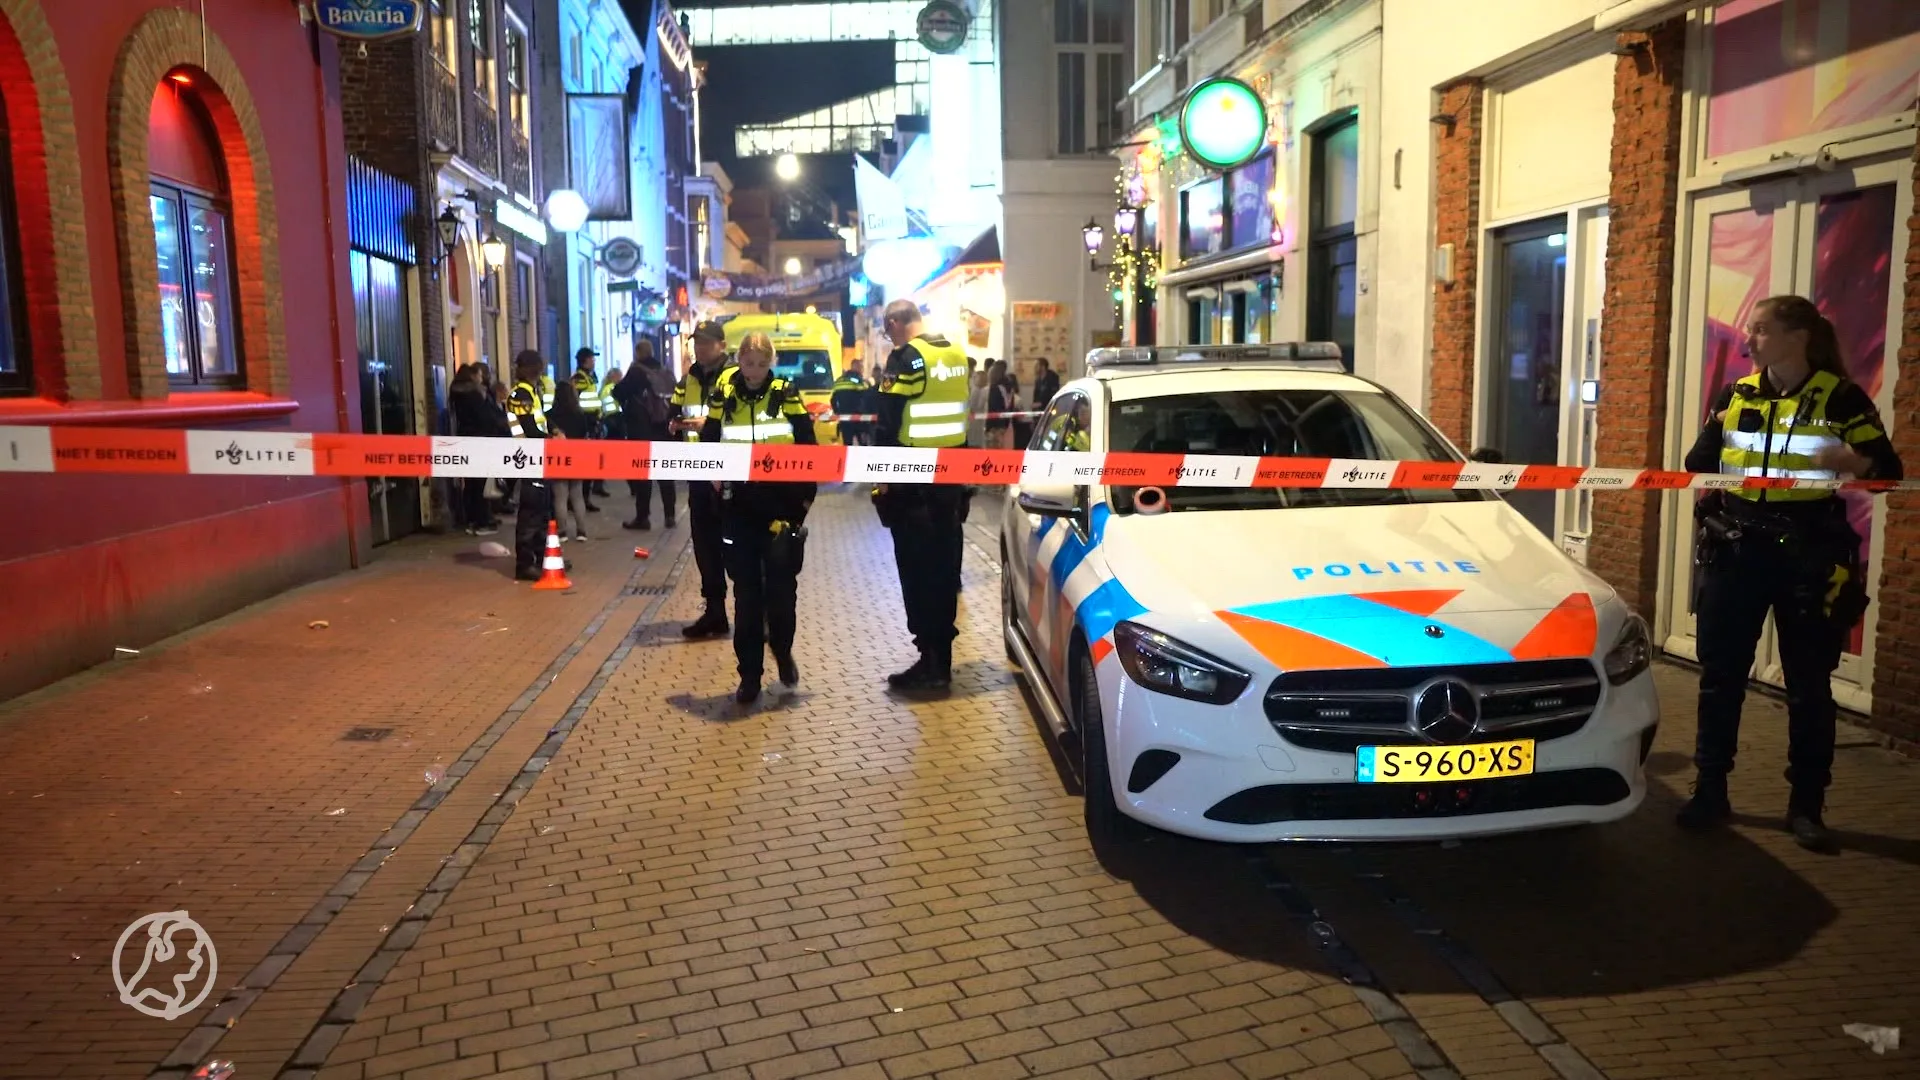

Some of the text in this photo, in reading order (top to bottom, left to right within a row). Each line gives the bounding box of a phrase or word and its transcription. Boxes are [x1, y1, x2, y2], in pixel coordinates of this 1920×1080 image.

[328, 6, 405, 25] Bavaria
[56, 447, 177, 461] NIET BETREDEN
[364, 454, 470, 467] NIET BETREDEN
[631, 455, 725, 469] NIET BETREDEN
[866, 462, 949, 474] NIET BETREDEN
[1074, 467, 1146, 478] NIET BETREDEN
[1258, 471, 1324, 481] NIET BETREDEN
[1421, 472, 1482, 482] NIET BETREDEN
[1587, 477, 1624, 485] BETREDEN
[1291, 560, 1481, 582] POLITIE
[1383, 745, 1522, 777] S-960-XS
